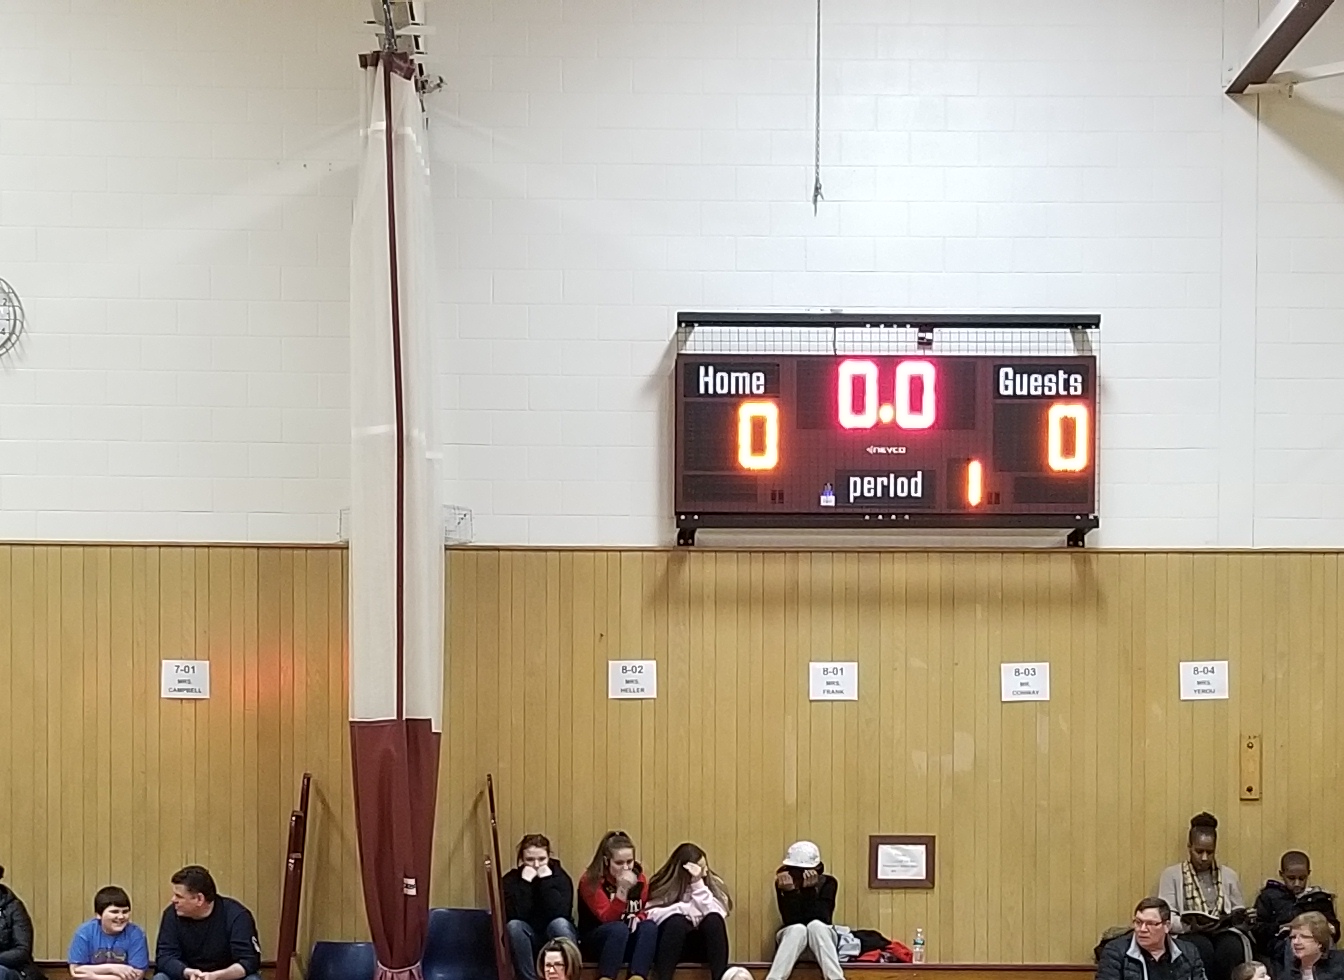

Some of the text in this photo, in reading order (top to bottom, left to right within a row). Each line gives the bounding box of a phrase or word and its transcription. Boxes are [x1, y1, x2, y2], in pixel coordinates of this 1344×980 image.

[698, 365, 766, 395] Home
[837, 358, 937, 430] 0.0
[998, 366, 1083, 396] Guests
[737, 400, 780, 471] 0
[1047, 402, 1089, 472] 0
[848, 470, 923, 503] period
[966, 459, 983, 507] 1
[174, 664, 196, 674] 7-01
[822, 666, 844, 676] 8-01
[1014, 667, 1037, 677] 8-03
[1193, 666, 1215, 676] 8-04
